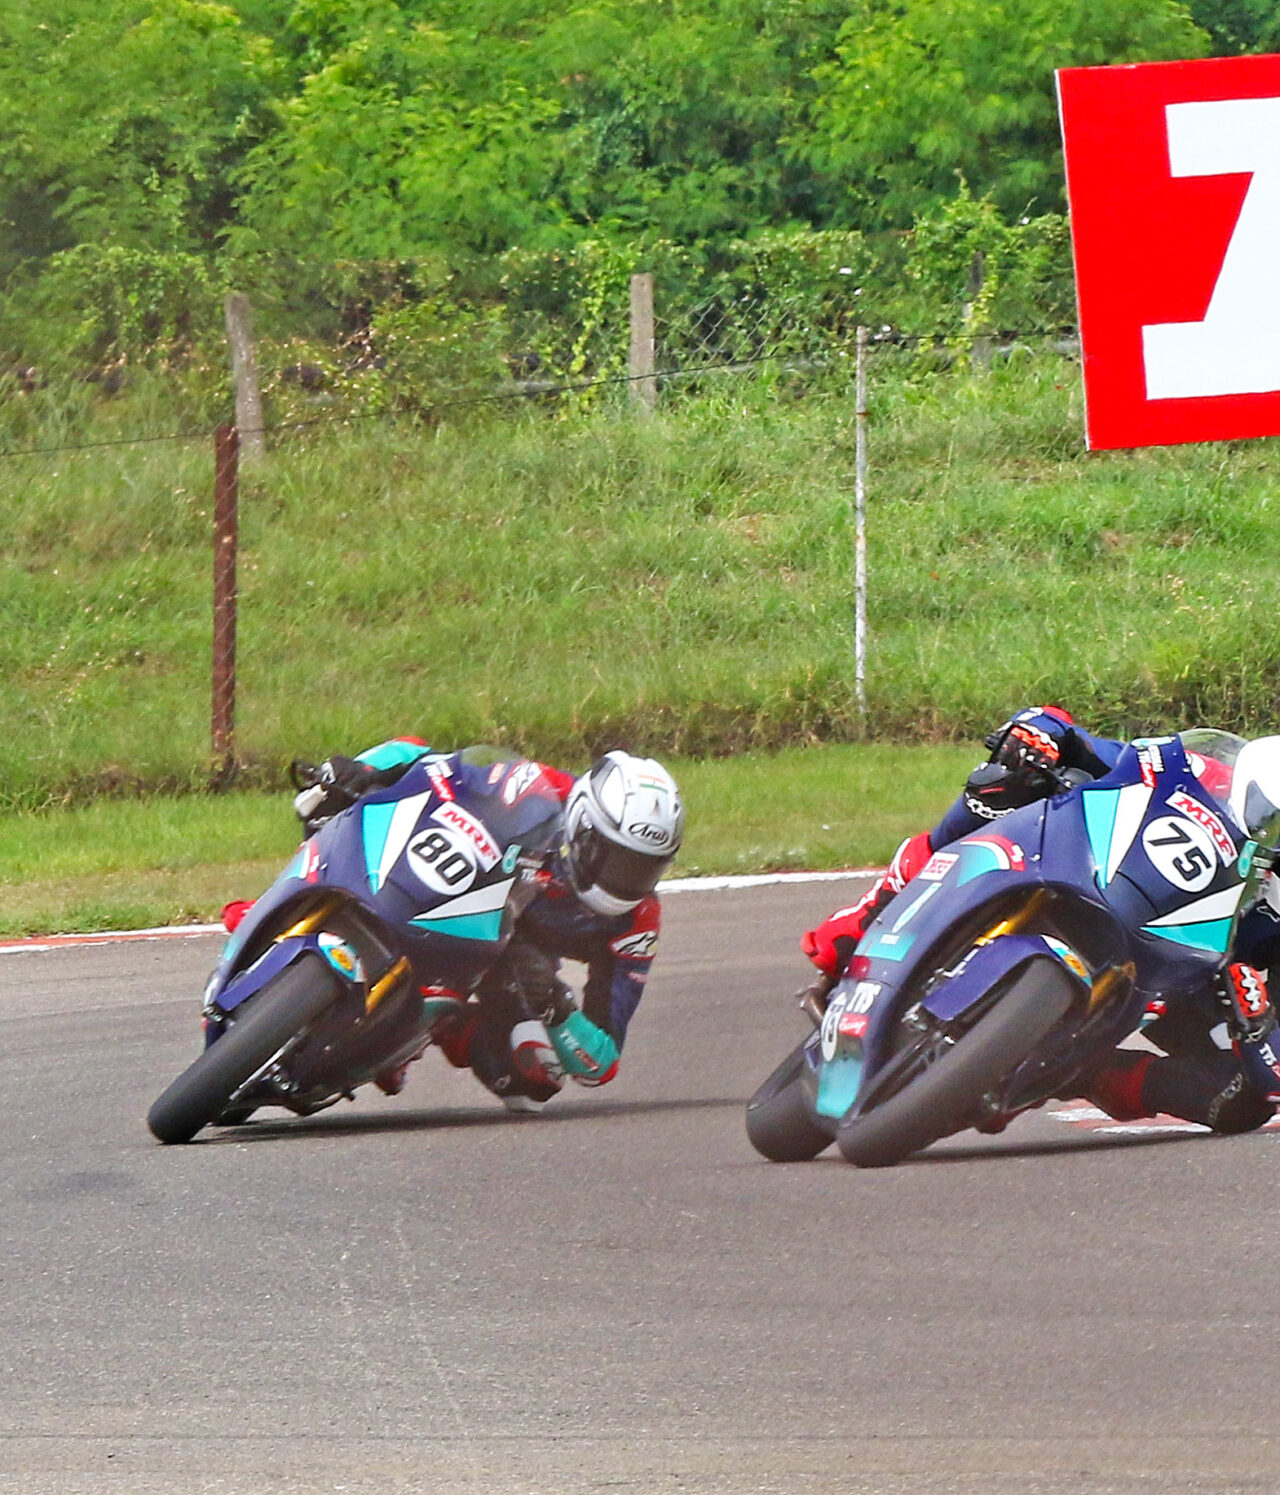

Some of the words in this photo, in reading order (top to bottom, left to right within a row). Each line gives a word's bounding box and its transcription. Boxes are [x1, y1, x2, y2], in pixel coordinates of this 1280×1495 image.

[442, 810, 498, 861] MRF
[1147, 822, 1212, 882] 75
[1173, 796, 1234, 858] MRF
[411, 833, 474, 886] 80
[1259, 1043, 1277, 1067] TVS
